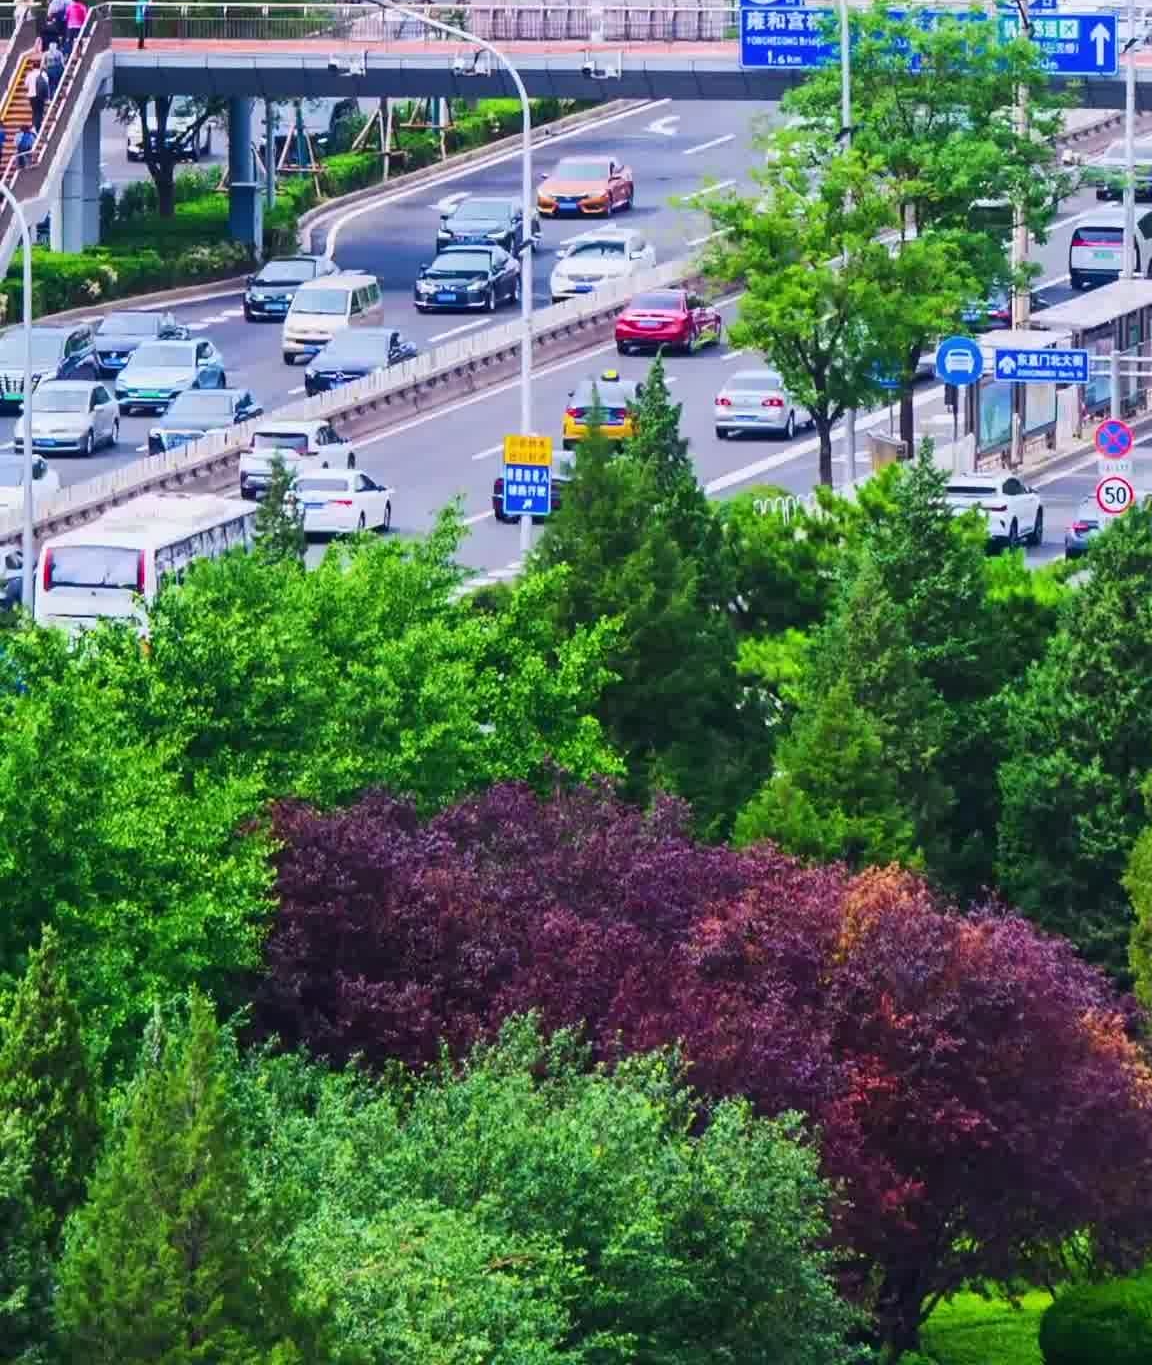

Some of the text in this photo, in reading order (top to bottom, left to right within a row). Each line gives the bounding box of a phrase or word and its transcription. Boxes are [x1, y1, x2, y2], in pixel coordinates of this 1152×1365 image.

[1017, 353, 1084, 367] 东直门北大街
[1105, 486, 1127, 505] 50
